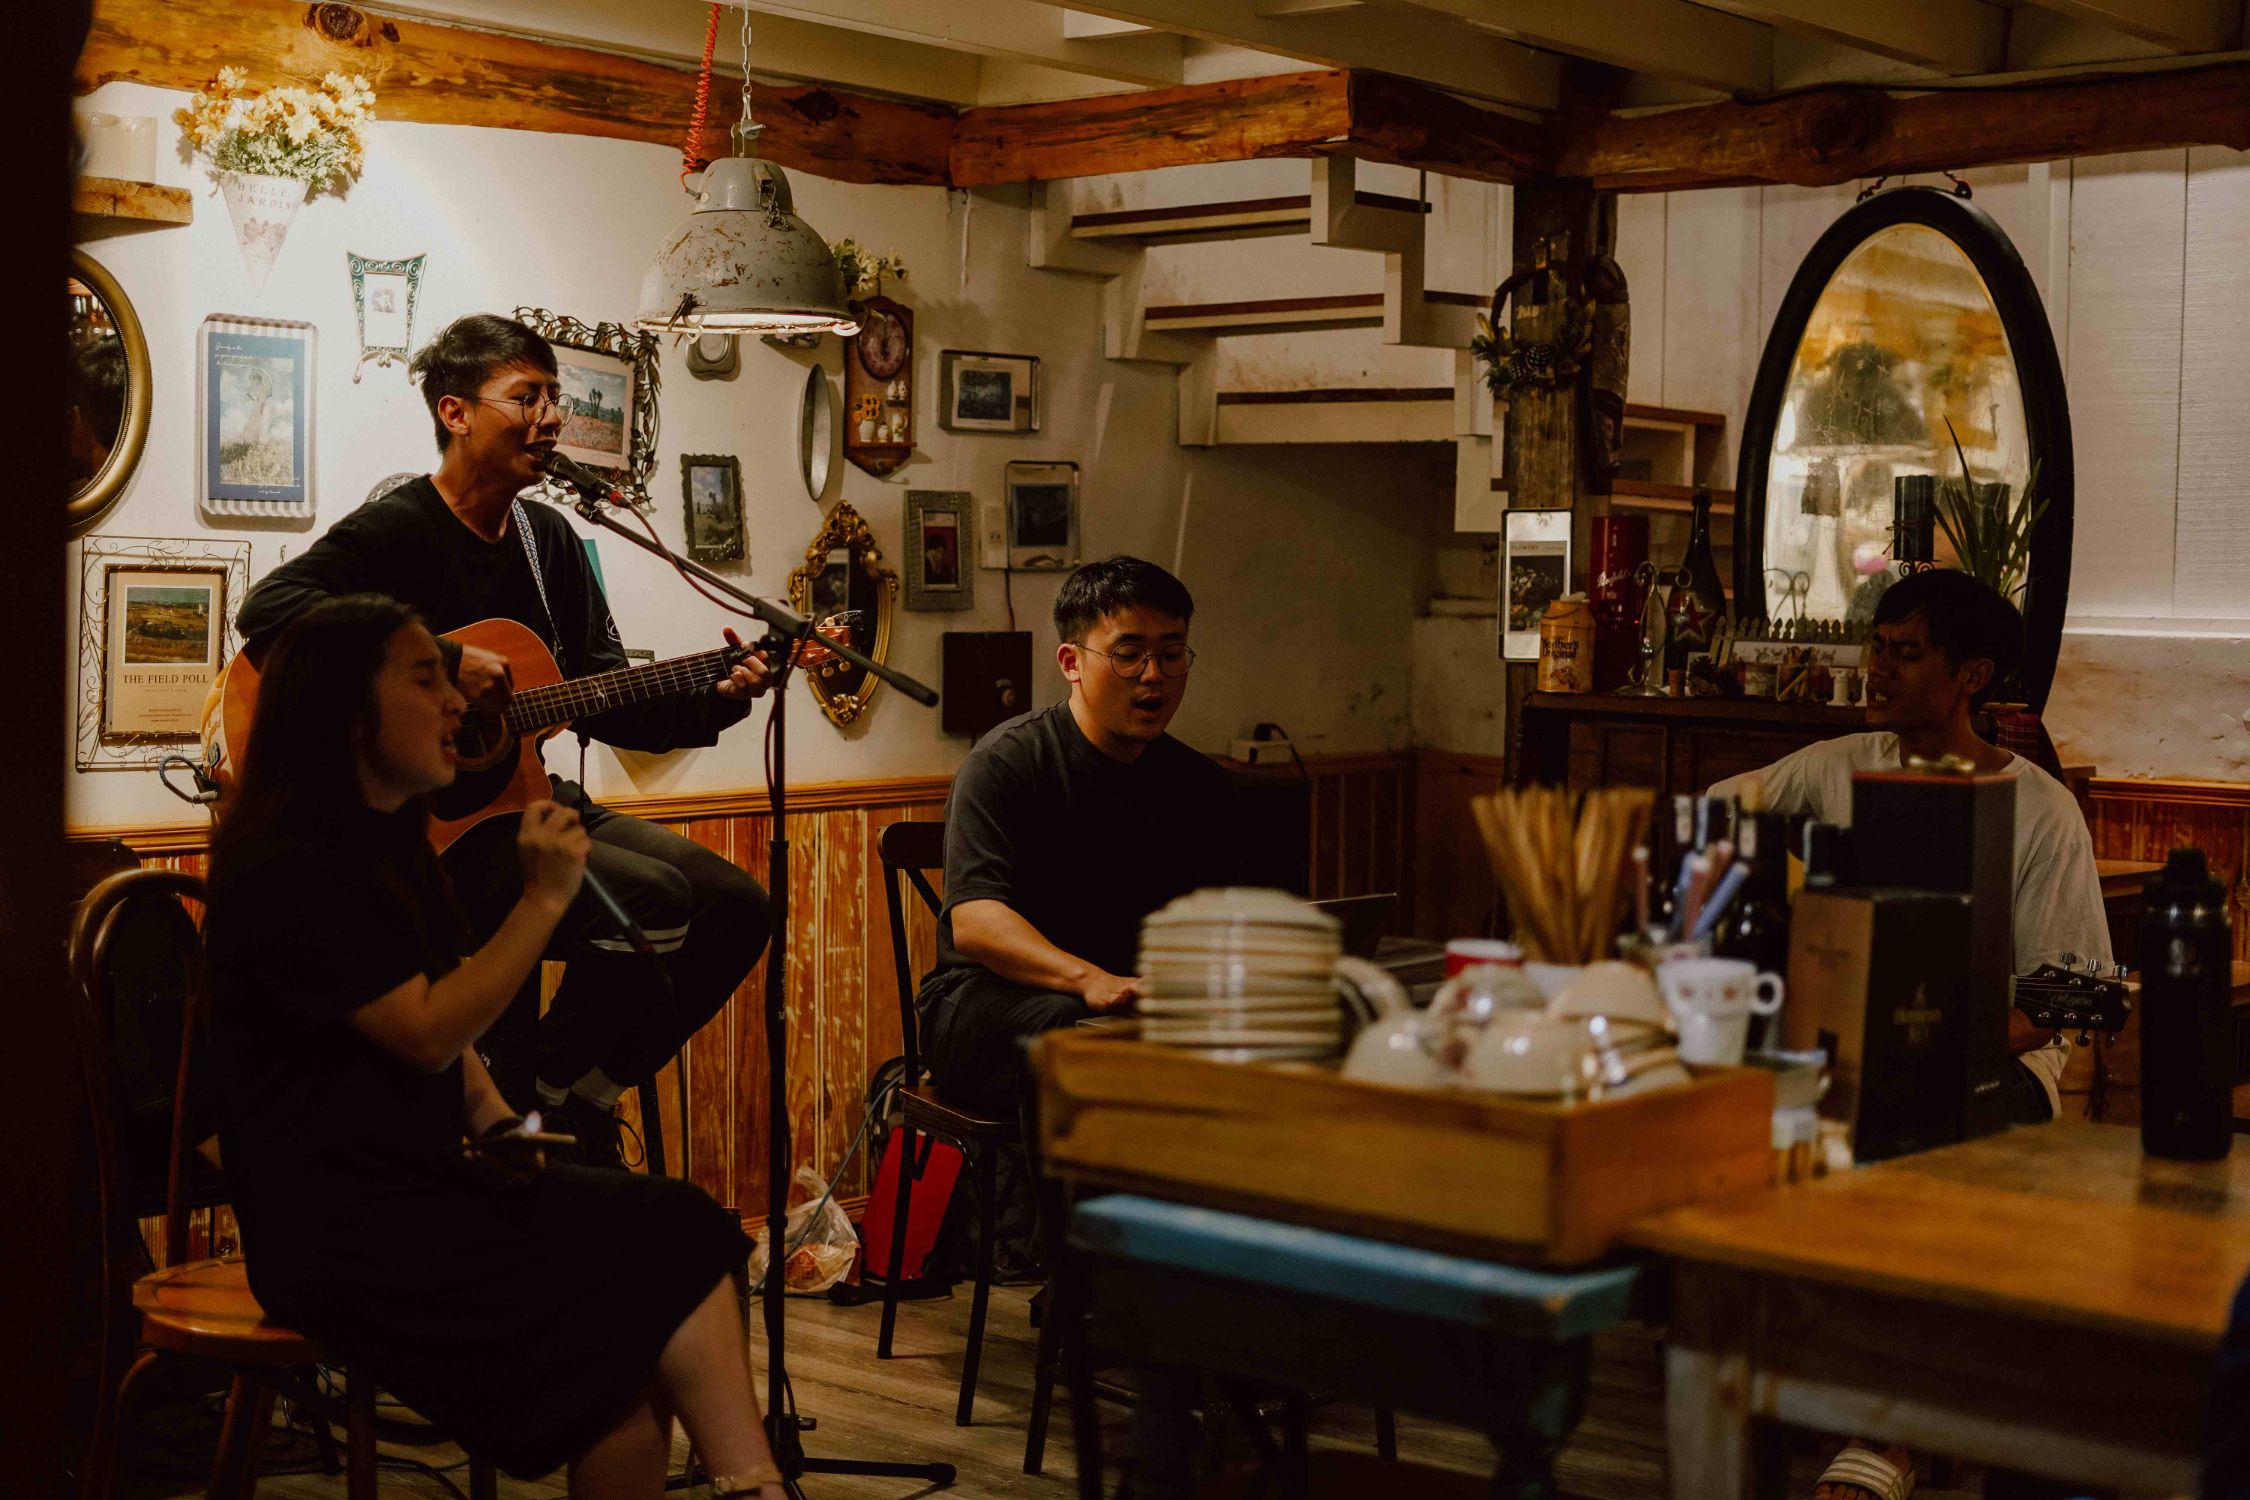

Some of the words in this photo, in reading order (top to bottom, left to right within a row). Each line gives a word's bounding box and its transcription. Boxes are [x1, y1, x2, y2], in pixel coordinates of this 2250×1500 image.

[237, 182, 288, 197] BELLE
[123, 674, 145, 684] THE
[148, 674, 179, 684] FIELD
[183, 674, 209, 684] POLL
